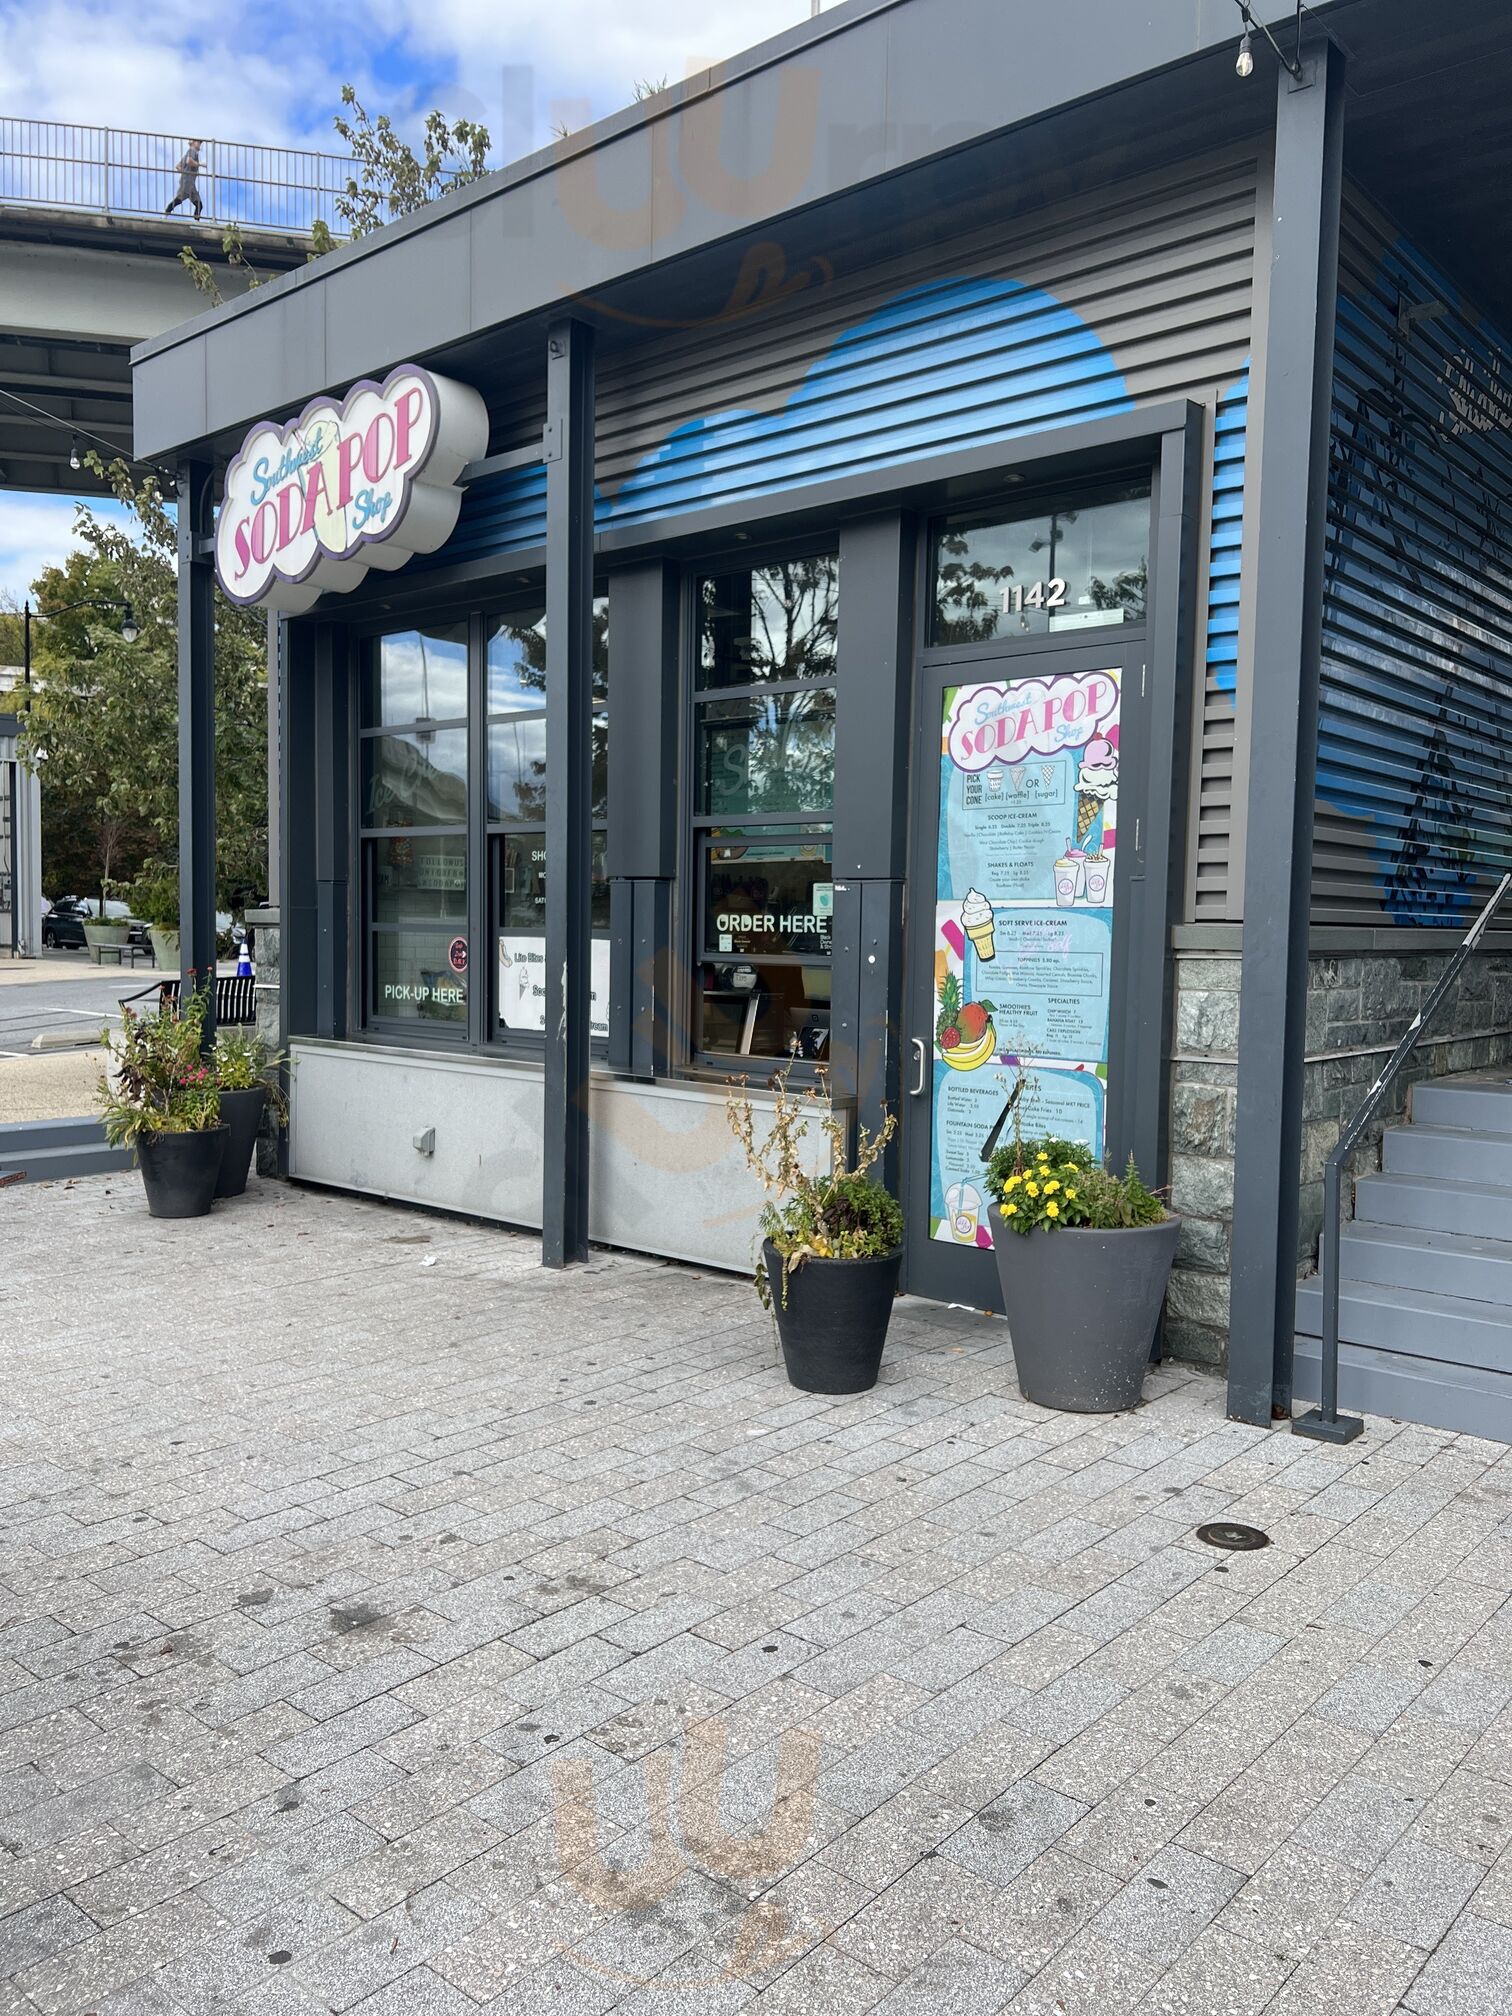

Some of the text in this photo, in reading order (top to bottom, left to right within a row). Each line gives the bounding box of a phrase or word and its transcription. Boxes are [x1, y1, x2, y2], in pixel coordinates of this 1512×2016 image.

[250, 425, 324, 507] Southwest
[233, 386, 424, 582] SODA POP
[351, 487, 394, 531] Shop
[999, 576, 1067, 615] 1142
[974, 691, 1034, 726] Southwest
[960, 680, 1108, 762] SODA POP
[1053, 723, 1086, 744] Shop
[966, 774, 981, 783] PICK
[1025, 778, 1040, 788] OR
[966, 784, 983, 794] YOUR
[966, 795, 983, 805] CONE
[987, 812, 1038, 821] SCOOP ICE-CREAM
[716, 913, 828, 934] ORDER HERE
[1033, 919, 1068, 927] ICE-CREAM
[384, 984, 465, 1004] PICK-UP HERE
[1047, 997, 1081, 1005] SPECIALTIES
[999, 1003, 1031, 1011] SMOOTHIES
[947, 1086, 999, 1096] BOTTLED BEVERAGES
[946, 1120, 973, 1129] FOUNTAIN
